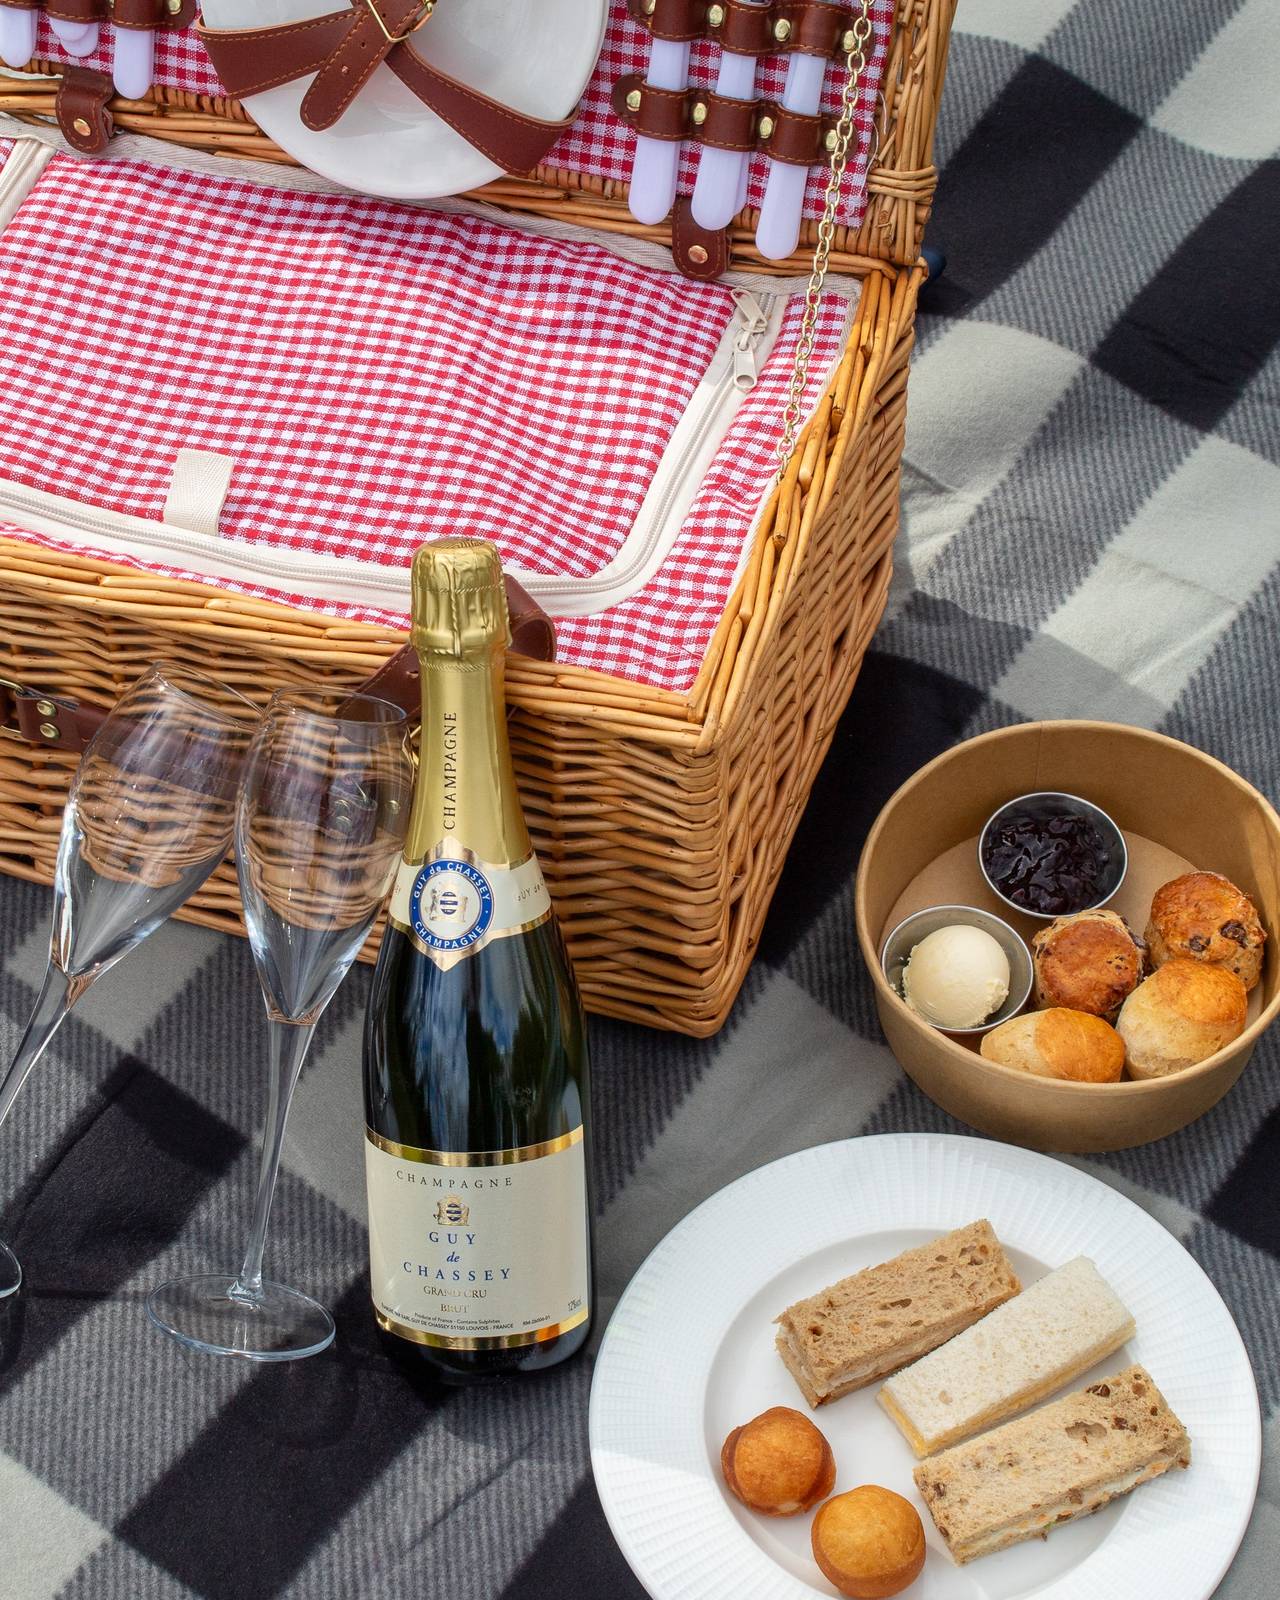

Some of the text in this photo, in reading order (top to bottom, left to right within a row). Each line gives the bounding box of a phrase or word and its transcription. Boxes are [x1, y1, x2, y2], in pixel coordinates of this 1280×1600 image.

[443, 712, 457, 830] CHAMPAGNE
[413, 874, 427, 898] GUY
[429, 865, 441, 875] de
[447, 862, 490, 900] CHASSEY
[415, 921, 484, 949] CHAMPAGNE
[396, 1170, 513, 1189] CHAMPAGNE
[429, 1231, 477, 1245] GUY
[446, 1251, 461, 1263] de
[403, 1261, 511, 1281] CHASSEY
[423, 1285, 487, 1299] GRAND CRU
[440, 1303, 470, 1313] BRUT
